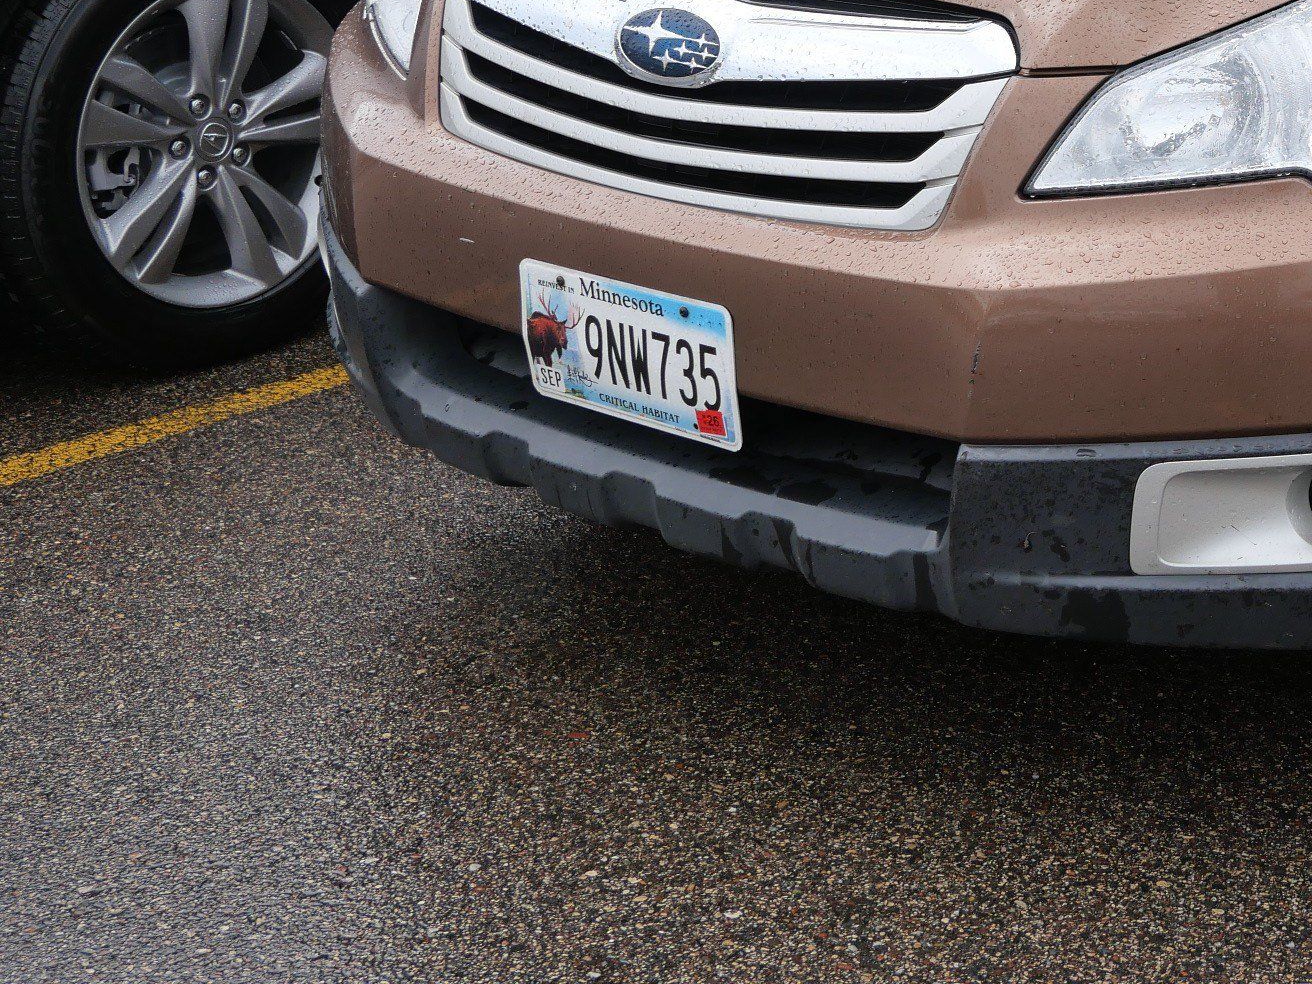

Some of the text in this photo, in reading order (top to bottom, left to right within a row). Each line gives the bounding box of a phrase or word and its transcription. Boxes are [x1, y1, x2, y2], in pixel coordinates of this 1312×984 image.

[579, 277, 664, 316] Minnesota
[541, 368, 561, 387] SEP
[585, 315, 722, 411] 9NW735
[599, 393, 680, 423] CRITICAL HABITAT
